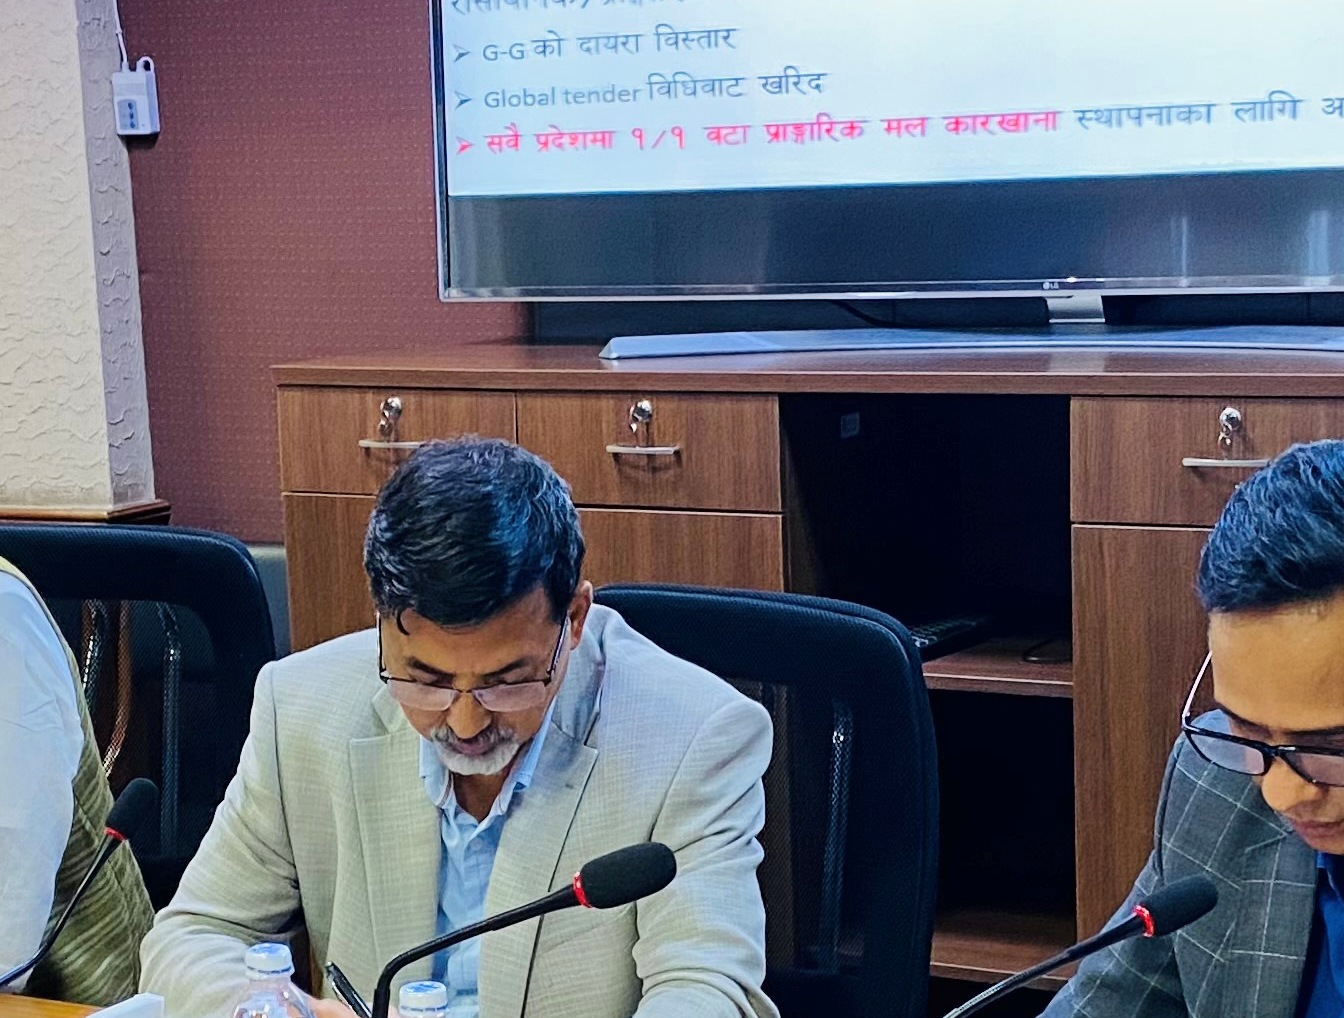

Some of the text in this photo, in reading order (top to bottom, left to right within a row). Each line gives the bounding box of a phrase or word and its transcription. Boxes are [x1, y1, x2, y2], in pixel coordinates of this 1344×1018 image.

[532, 30, 568, 58] को
[576, 34, 644, 54] दायरा
[653, 23, 740, 52] विस्तार
[484, 86, 555, 108] Global
[562, 84, 641, 105] tender
[757, 66, 828, 95] खरिद
[533, 124, 617, 152] प्रदेशमा
[702, 125, 753, 146] वटा
[880, 117, 931, 139] मल
[941, 110, 1062, 136] कारखाना
[1073, 103, 1217, 129] स्थापनाका
[1230, 90, 1305, 122] लागि
